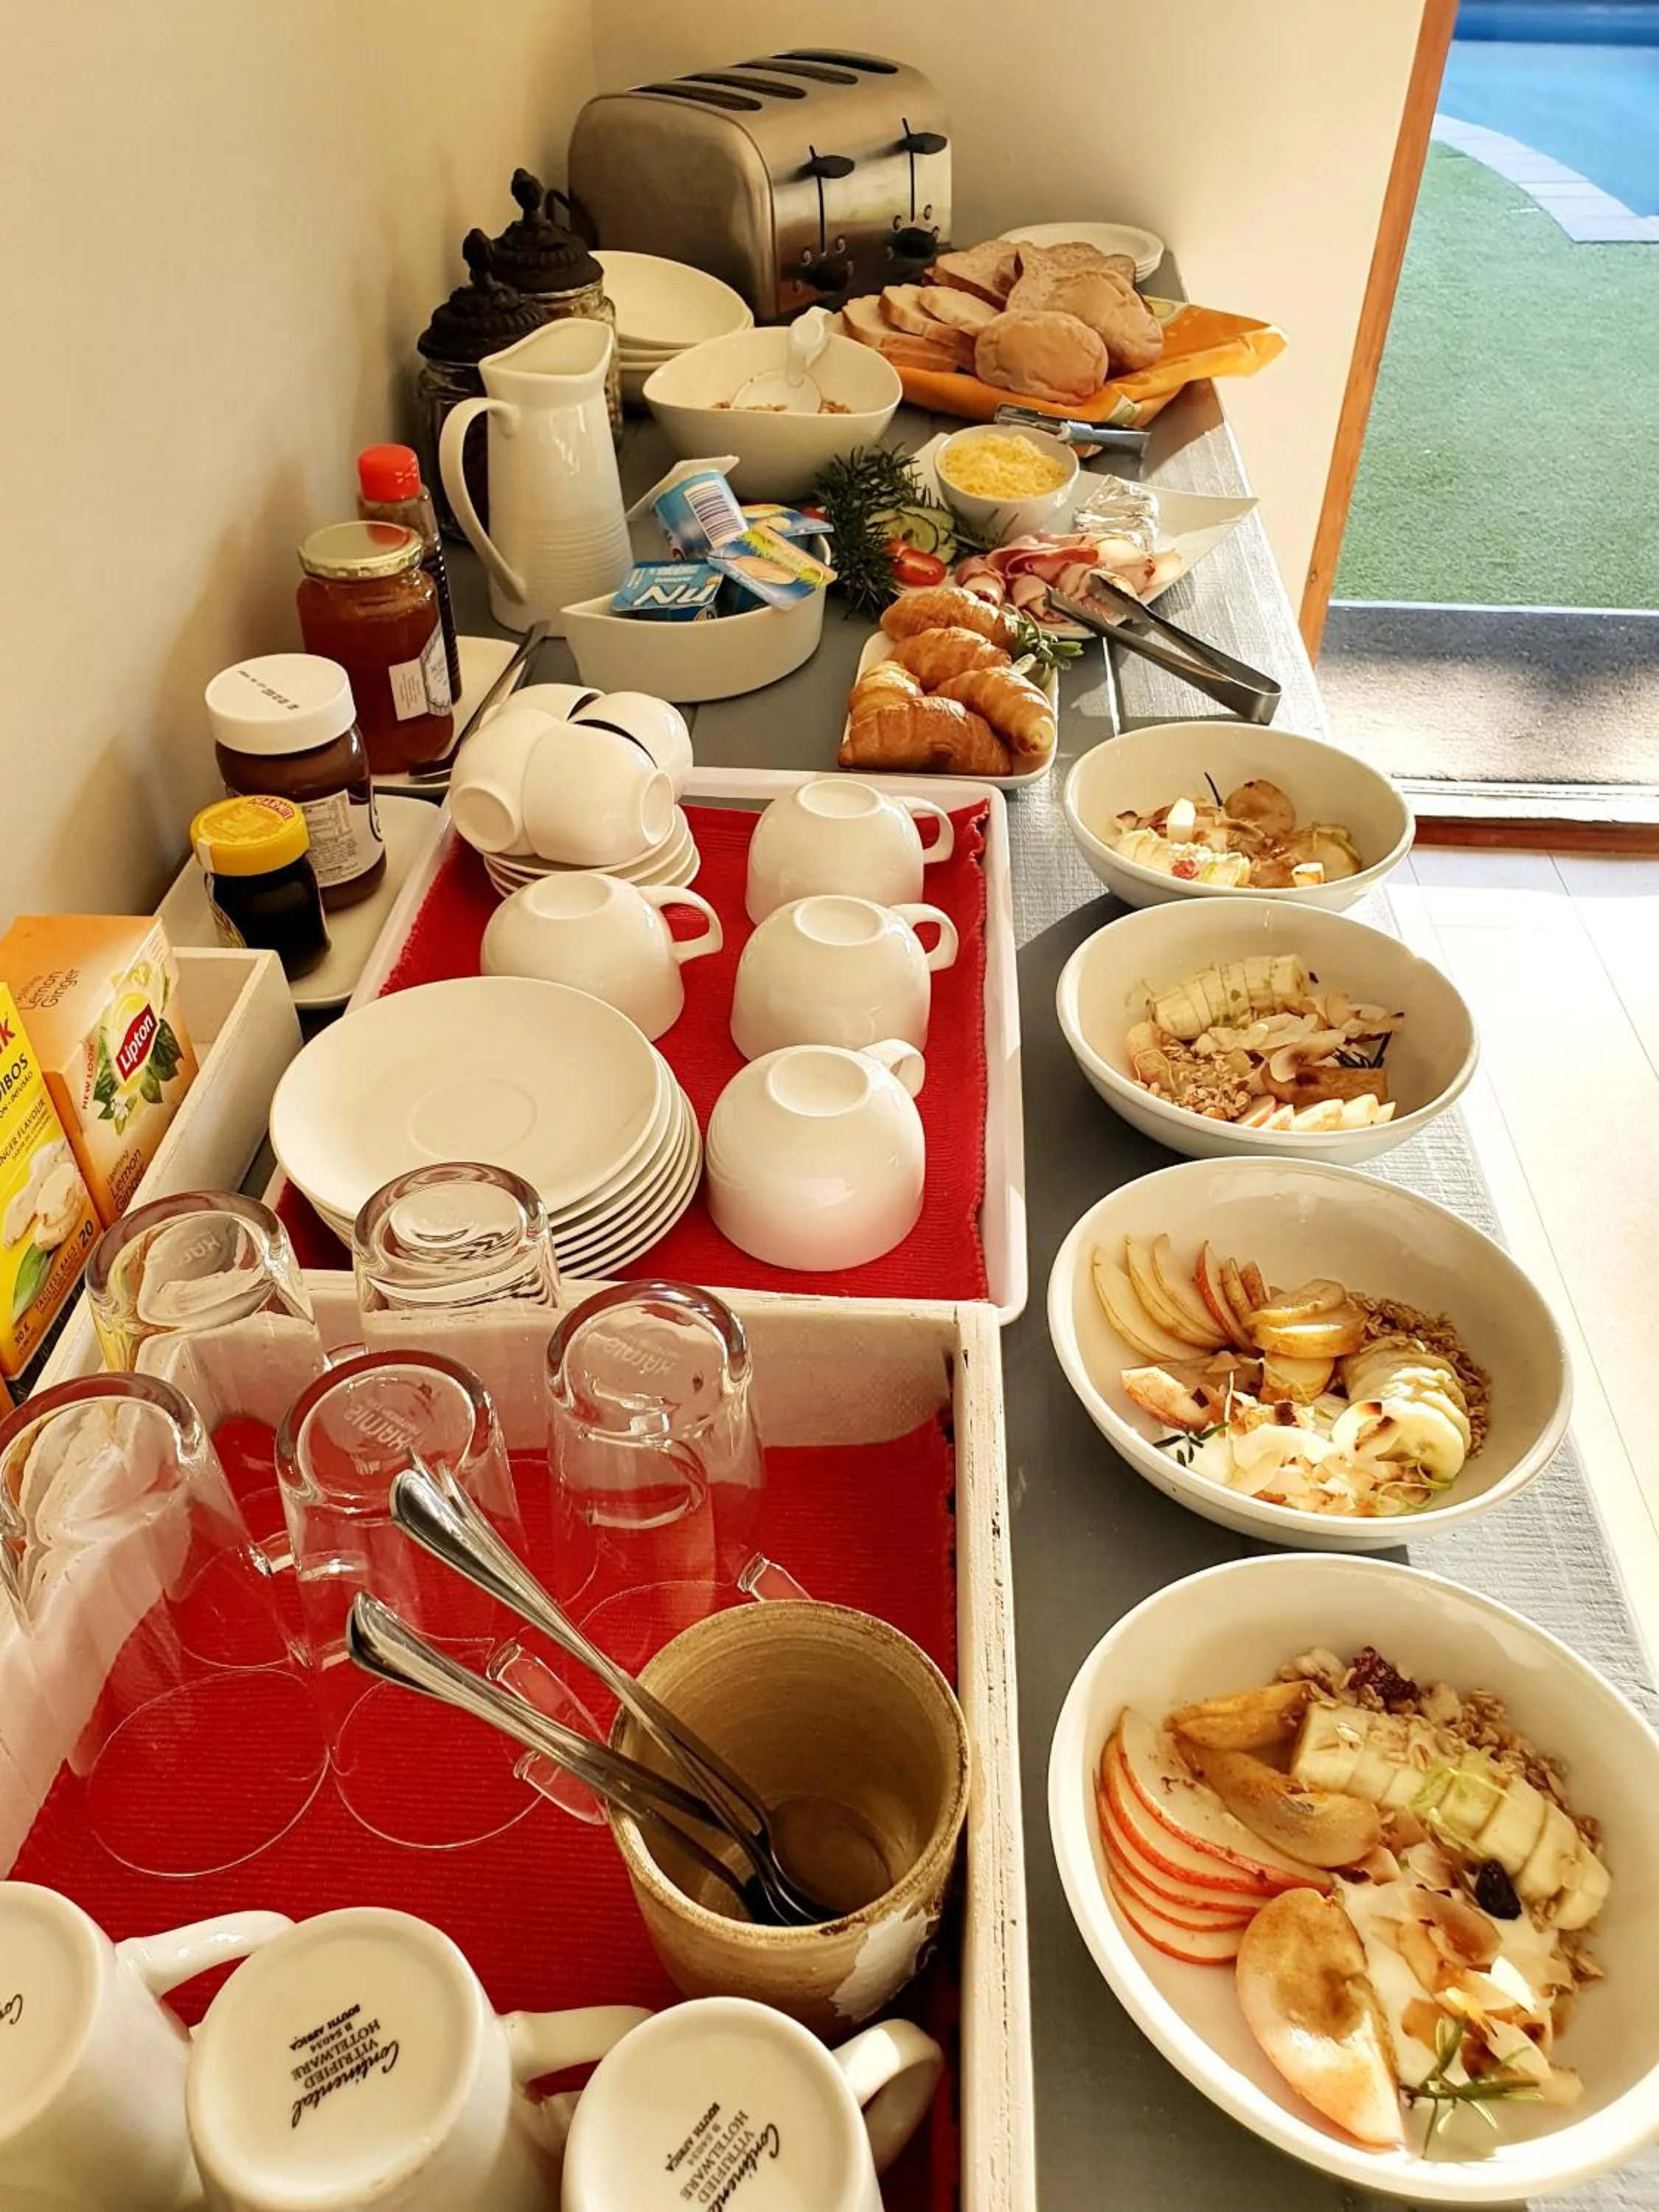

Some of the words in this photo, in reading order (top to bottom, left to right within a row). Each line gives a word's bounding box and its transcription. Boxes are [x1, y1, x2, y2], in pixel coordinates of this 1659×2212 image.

[119, 1015, 154, 1071] Lipton
[0, 1053, 28, 1096] IBOS
[79, 1220, 94, 1248] 20
[289, 2025, 324, 2051] AFRICA
[327, 2003, 361, 2029] SOUTH
[291, 2019, 380, 2081] HOTELWARE
[304, 2038, 379, 2089] VITRIFIED
[291, 2039, 399, 2129] Continental
[693, 2101, 720, 2138] SOUTH
[680, 2110, 749, 2201] HOTELWARE
[698, 2129, 755, 2204] VITRIFIED
[708, 2123, 779, 2212] Continent
